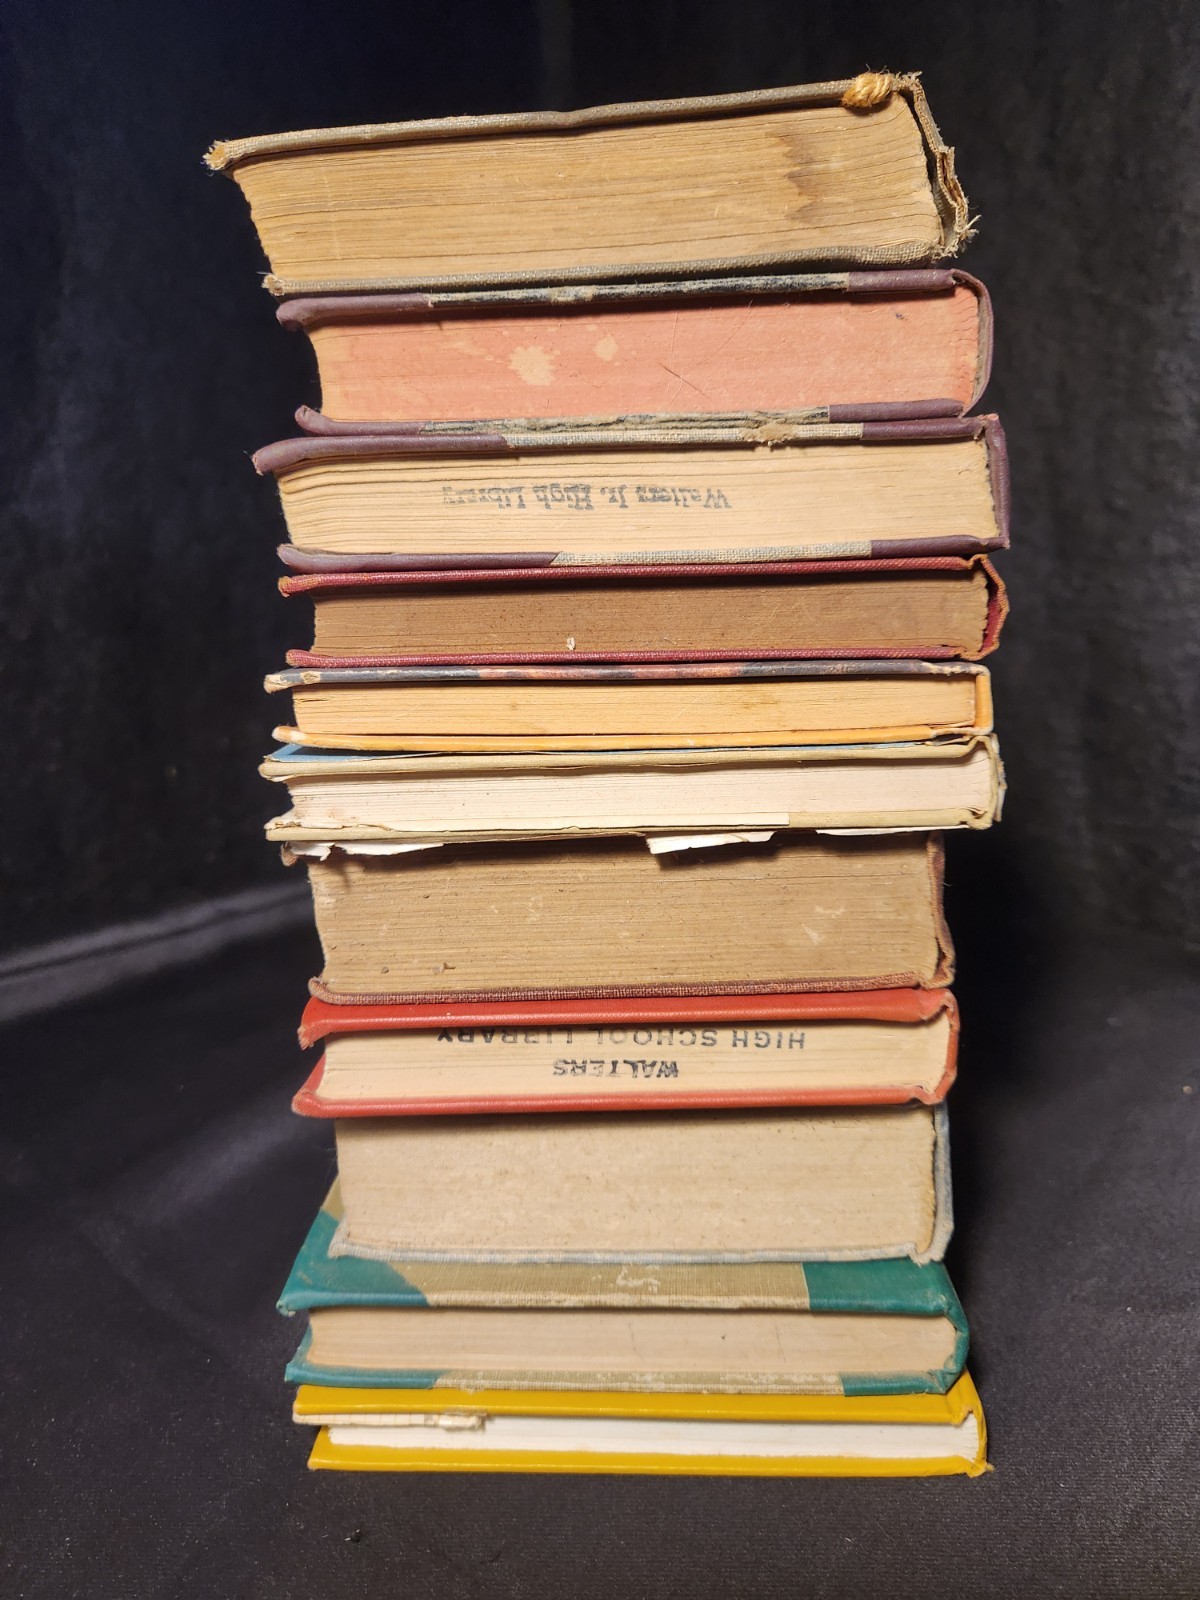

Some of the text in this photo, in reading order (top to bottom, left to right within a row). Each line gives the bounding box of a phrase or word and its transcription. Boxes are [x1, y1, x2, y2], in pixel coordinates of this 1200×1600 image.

[532, 483, 594, 510] High
[600, 484, 629, 508] Jr.
[437, 1027, 805, 1049] HIGH SCHOOL LIBRARY
[553, 1058, 679, 1078] WALTERS
